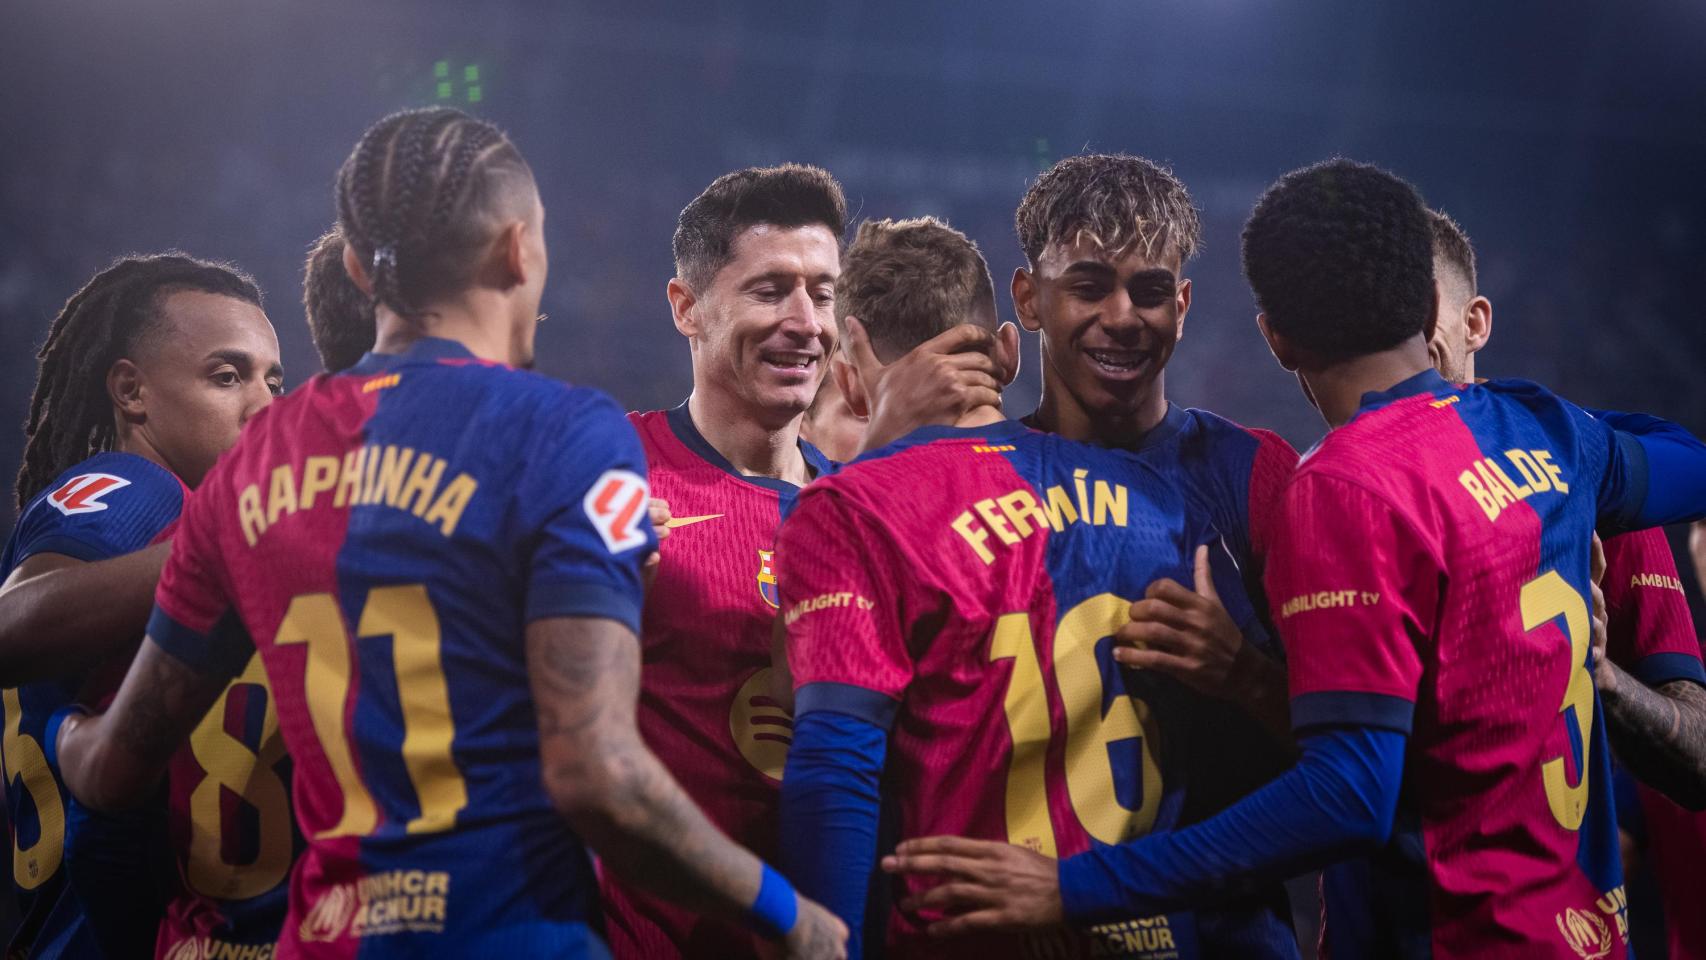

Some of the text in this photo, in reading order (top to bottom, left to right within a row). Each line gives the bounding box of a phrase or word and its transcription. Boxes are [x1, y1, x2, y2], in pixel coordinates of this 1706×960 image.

[239, 445, 478, 547] RAPHINHA
[951, 468, 1128, 566] FERMÍN
[1458, 448, 1569, 523] BALDE
[189, 650, 293, 899] 8
[275, 584, 468, 839] 11
[990, 592, 1163, 859] 16
[1520, 570, 1593, 831] 3
[204, 938, 279, 960] UNHC
